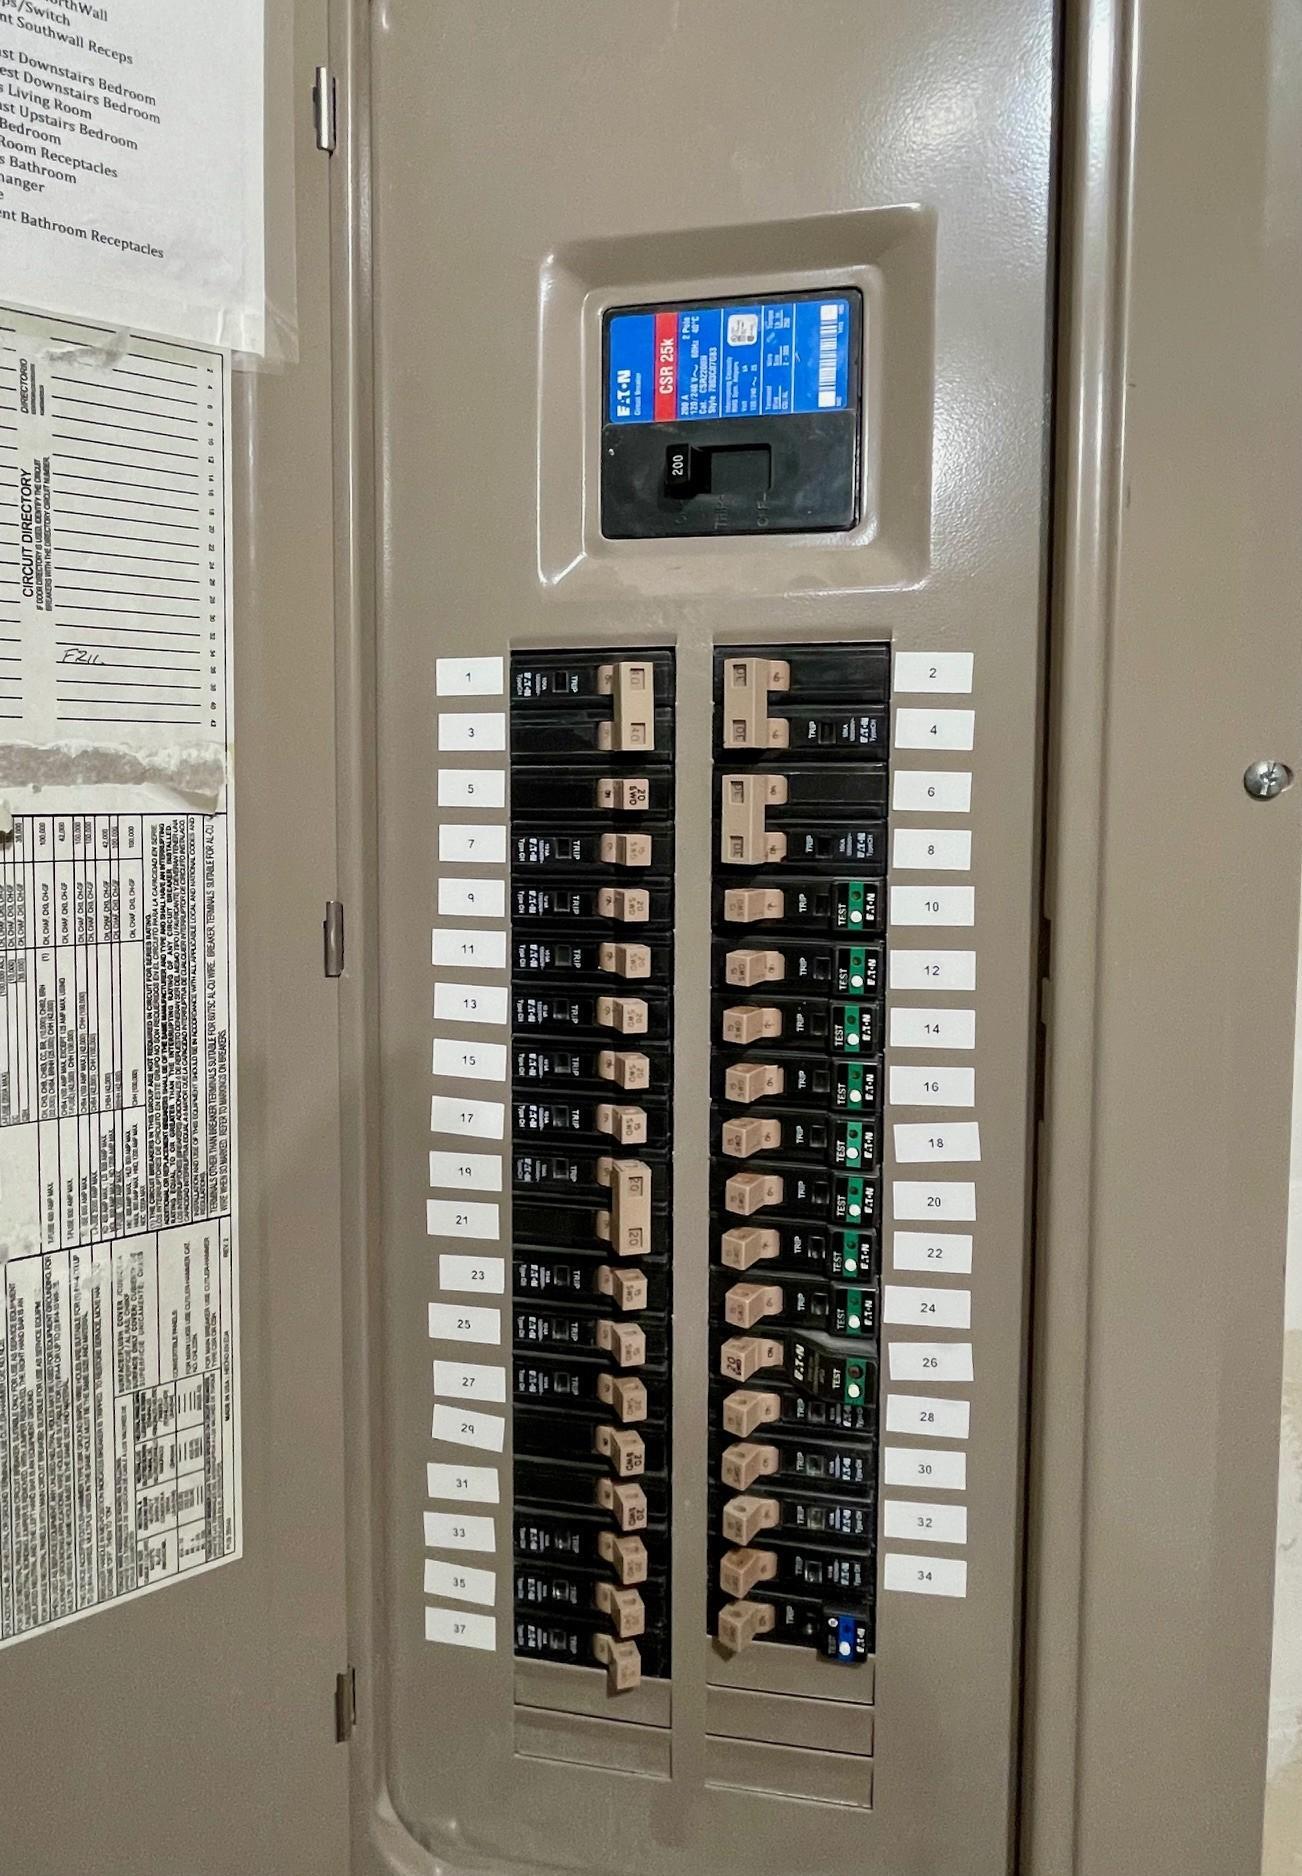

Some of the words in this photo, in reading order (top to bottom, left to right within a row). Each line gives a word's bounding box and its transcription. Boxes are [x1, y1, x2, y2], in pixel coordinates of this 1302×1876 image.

[45, 0, 108, 21] orthWall
[17, 16, 84, 48] Southwall
[88, 40, 133, 64] Receps
[18, 52, 95, 86] Downstairs
[98, 78, 156, 106] Bedroom
[8, 83, 50, 110] Living
[54, 98, 92, 120] Room
[23, 71, 99, 105] Downstairs
[103, 97, 161, 124] Bedroom
[0, 116, 61, 145] Bedroom
[19, 106, 76, 132] Upstairs
[79, 123, 138, 150] Bedroom
[41, 147, 118, 178] Receptacles
[9, 156, 77, 183] Bathroom
[20, 211, 87, 239] Bathroom
[91, 230, 164, 258] Receptacles
[660, 338, 674, 362] 25k
[659, 366, 673, 394] CSR
[673, 454, 683, 475] 200
[21, 469, 32, 543] DIRECTORY
[22, 547, 33, 597] CIRCUIT
[466, 672, 470, 681] 1
[929, 668, 936, 678] 2
[468, 728, 474, 737] 3
[930, 725, 937, 734] 4
[468, 784, 474, 793] 5
[928, 787, 935, 797] 6
[637, 788, 646, 802] 20
[469, 839, 474, 848] 7
[928, 845, 934, 855] 8
[468, 893, 474, 902] 9
[799, 894, 807, 912] TRIP
[925, 902, 939, 912] 10
[838, 904, 846, 925] TEST
[462, 944, 473, 954] 11
[924, 966, 940, 975] 12
[839, 969, 847, 990] TEST
[464, 999, 476, 1009] 13
[796, 1014, 804, 1031] TRIP
[924, 1024, 939, 1034] 14
[835, 1025, 843, 1046] TEST
[462, 1056, 475, 1065] 15
[924, 1082, 939, 1092] 16
[837, 1083, 846, 1104] TEST
[461, 1113, 473, 1123] 17
[796, 1126, 804, 1143] TRIP
[928, 1138, 943, 1148] 18
[836, 1141, 845, 1162] TEST
[458, 1167, 471, 1176] 19
[837, 1195, 846, 1215] TEST
[928, 1197, 941, 1207] 20
[456, 1215, 467, 1225] 21
[928, 1248, 942, 1258] 22
[833, 1252, 841, 1272] TEST
[472, 1270, 484, 1280] 23
[921, 1303, 935, 1313] 24
[457, 1319, 470, 1329] 25
[837, 1309, 845, 1329] TEST
[923, 1358, 937, 1367] 26
[462, 1377, 475, 1386] 27
[832, 1369, 840, 1388] TEST
[920, 1412, 934, 1422] 28
[461, 1423, 474, 1434] 29
[918, 1464, 932, 1474] 30
[457, 1479, 467, 1488] 31
[918, 1517, 932, 1528] 32
[453, 1528, 465, 1537] 33
[918, 1571, 932, 1581] 34
[454, 1577, 465, 1588] 35
[455, 1624, 465, 1633] 37
